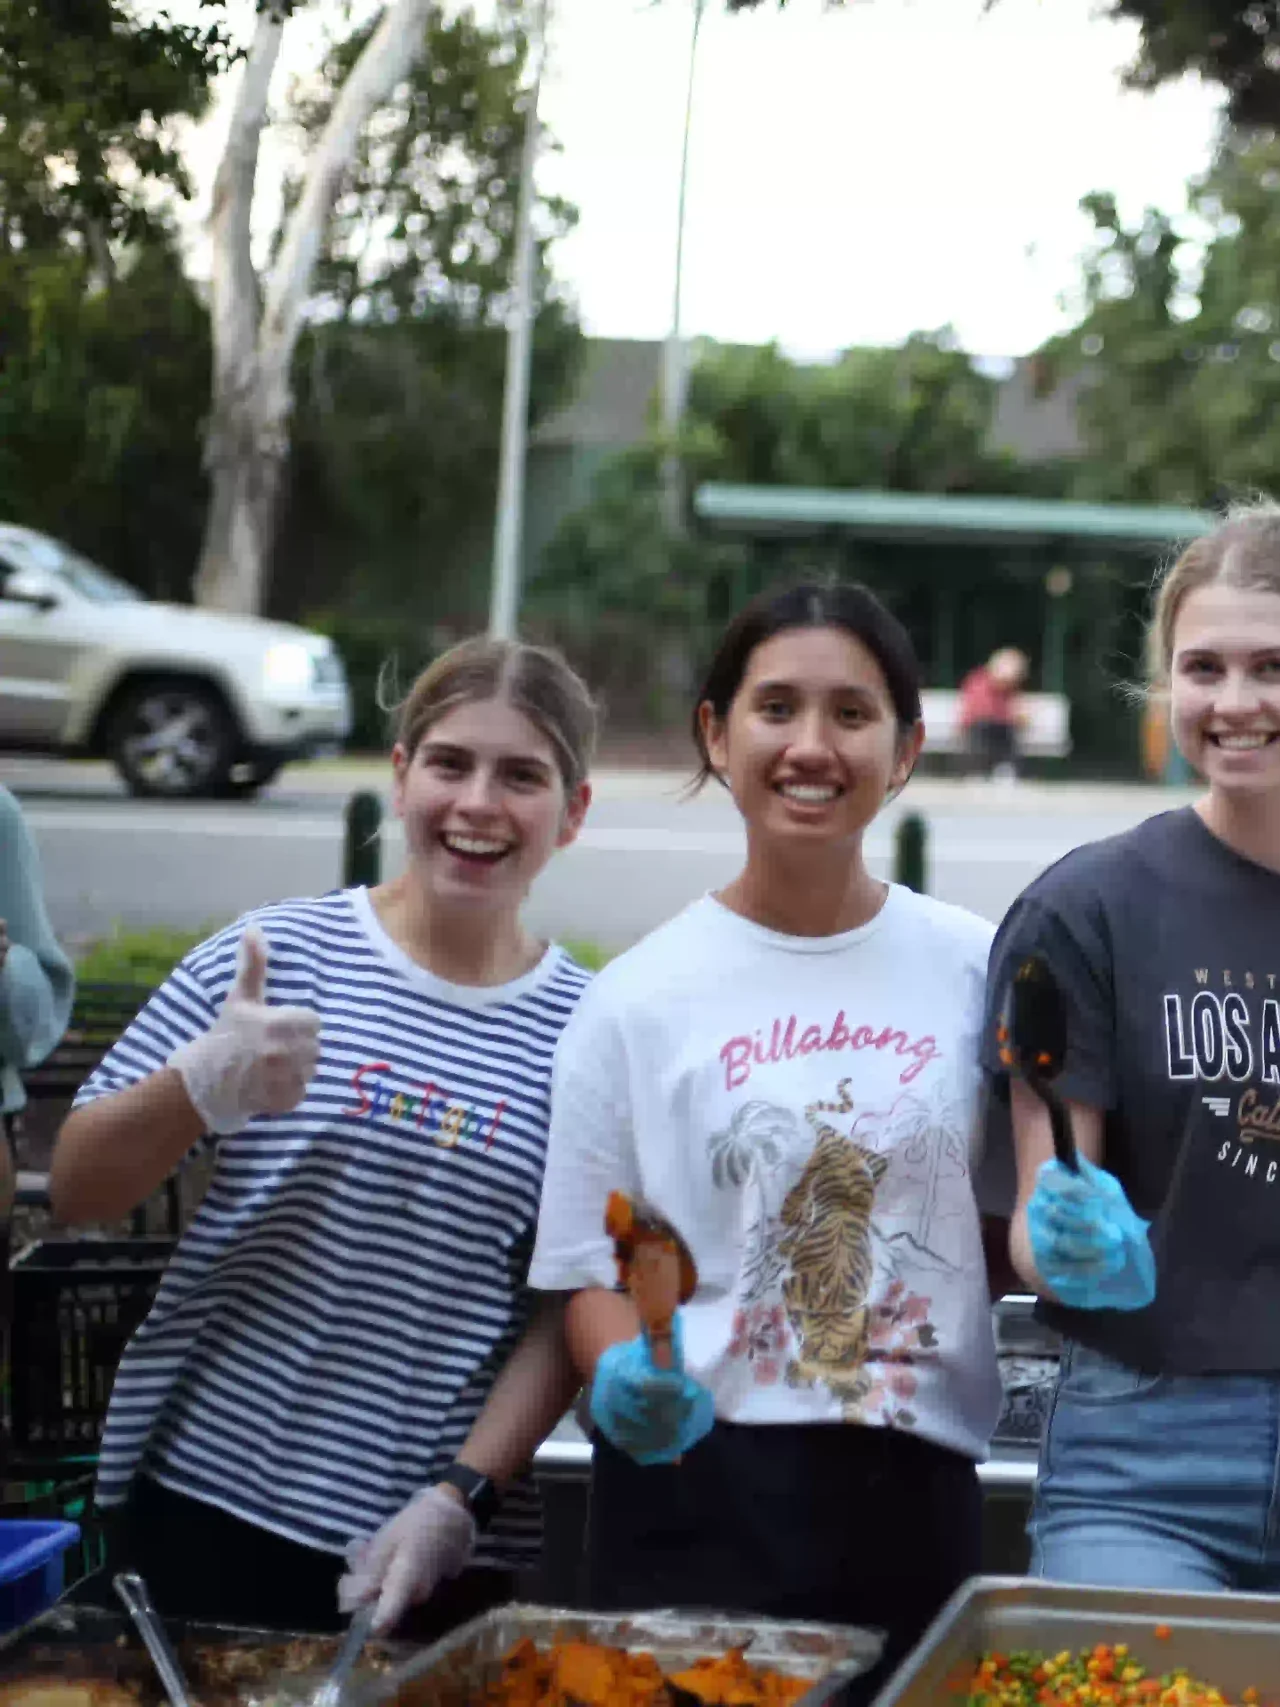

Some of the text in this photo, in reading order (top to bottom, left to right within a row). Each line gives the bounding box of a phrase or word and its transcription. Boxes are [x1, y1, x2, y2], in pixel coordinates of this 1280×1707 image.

[1194, 968, 1277, 990] WEST
[719, 1009, 943, 1092] Billabong
[1164, 990, 1253, 1081] LOS
